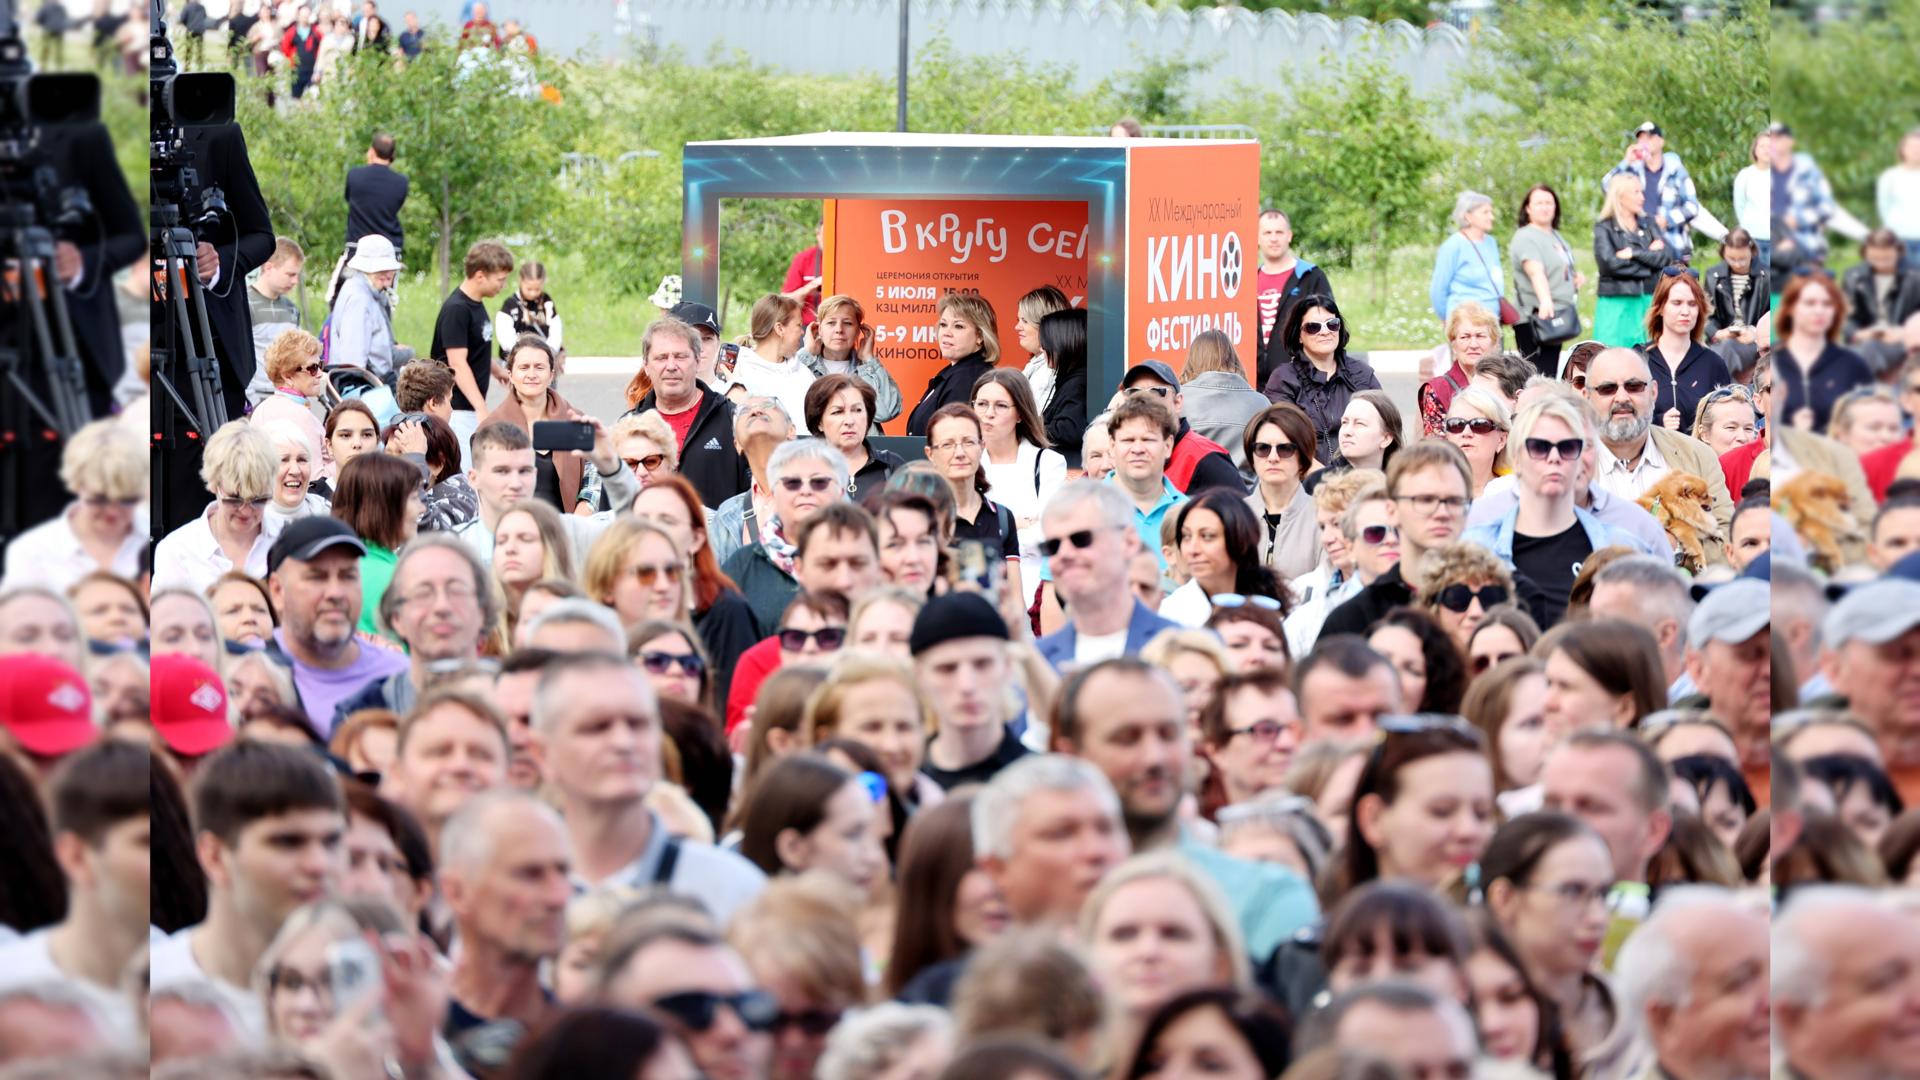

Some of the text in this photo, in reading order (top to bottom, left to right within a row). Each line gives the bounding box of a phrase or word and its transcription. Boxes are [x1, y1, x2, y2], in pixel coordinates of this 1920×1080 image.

[1164, 198, 1242, 228] Международный
[881, 209, 907, 253] В
[876, 272, 980, 281] ЦЕРЕМОНИЯ ОТКРЫТИЯ
[1147, 231, 1242, 304] КИНО
[876, 286, 884, 299] 5
[888, 287, 937, 300] ИЮЛЯ
[876, 303, 898, 314] КЗЦ
[875, 325, 907, 343] 5-9
